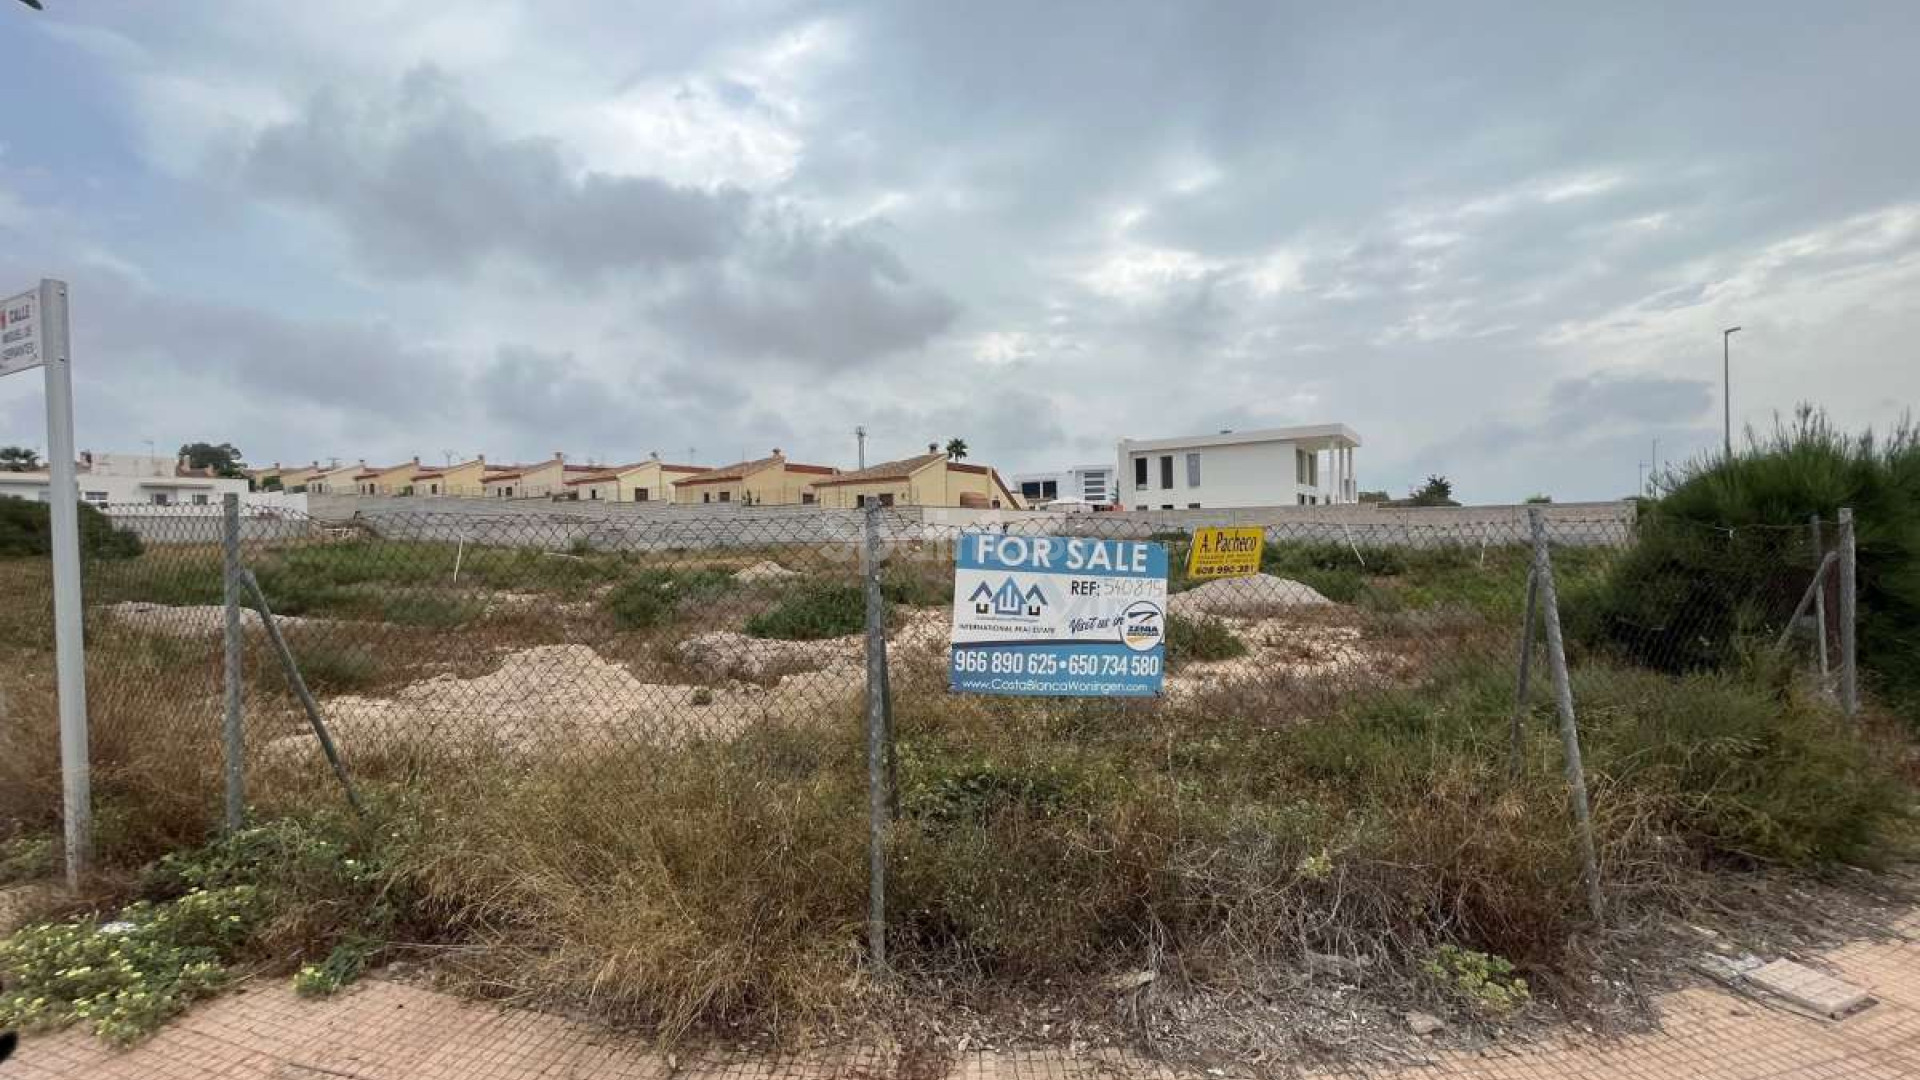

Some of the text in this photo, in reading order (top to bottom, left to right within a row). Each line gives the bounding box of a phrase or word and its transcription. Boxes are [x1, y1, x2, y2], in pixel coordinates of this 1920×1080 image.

[1215, 530, 1257, 552] Pacheco
[978, 533, 1148, 573] FOR SALE
[1071, 579, 1100, 597] REF:
[954, 651, 1160, 677] 966 890 625 650 734 580
[963, 678, 1148, 694] www.CostaBlancaWoningen.com
